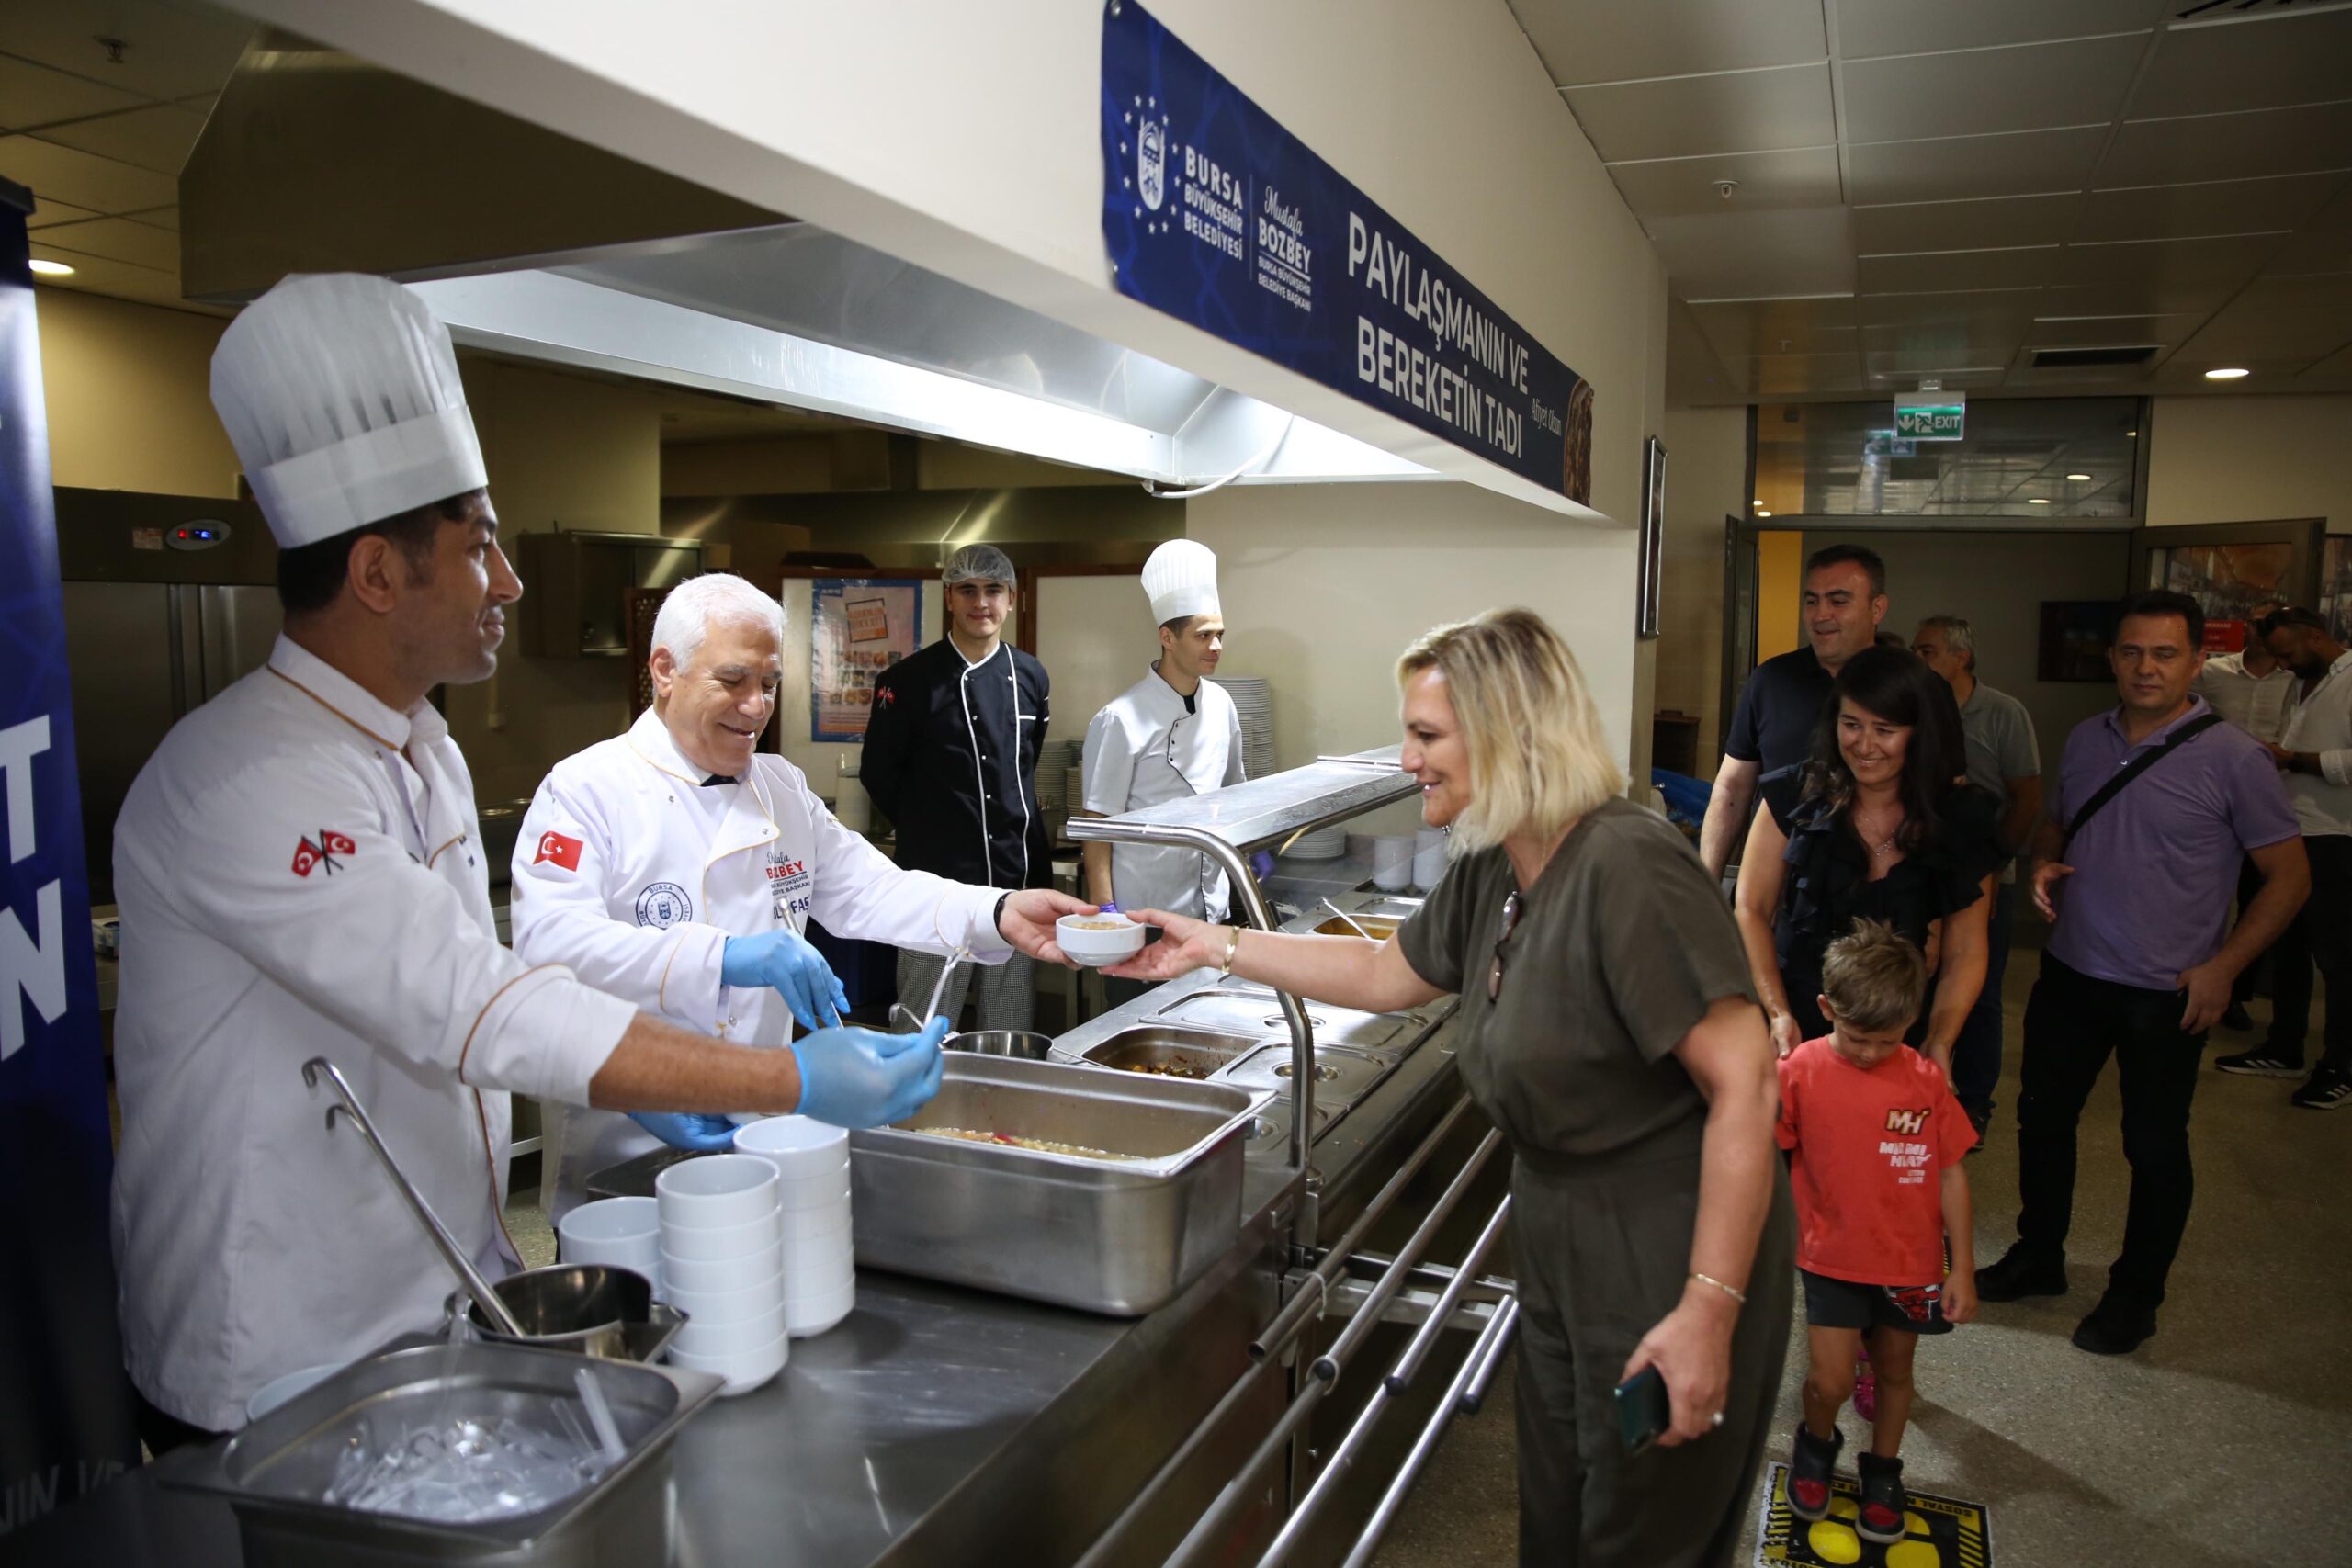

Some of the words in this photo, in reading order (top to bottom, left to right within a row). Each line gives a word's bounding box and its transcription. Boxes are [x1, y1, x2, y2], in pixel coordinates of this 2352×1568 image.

[1184, 144, 1243, 210] BURSA
[1184, 183, 1243, 235] BÜYÜKŞEHİR
[1184, 210, 1243, 261] BELEDİYESİ
[1264, 186, 1304, 242] Mustafa
[1258, 217, 1311, 274] BOZBEY
[1348, 210, 1506, 379] PAYLAŞMANIN
[1509, 338, 1529, 395] VE
[1358, 315, 1482, 438] BEREKETİN
[1485, 394, 1521, 459] TADI
[1935, 416, 1960, 428] EXIT
[648, 884, 673, 894] BURSA
[766, 860, 804, 879] BZBEY
